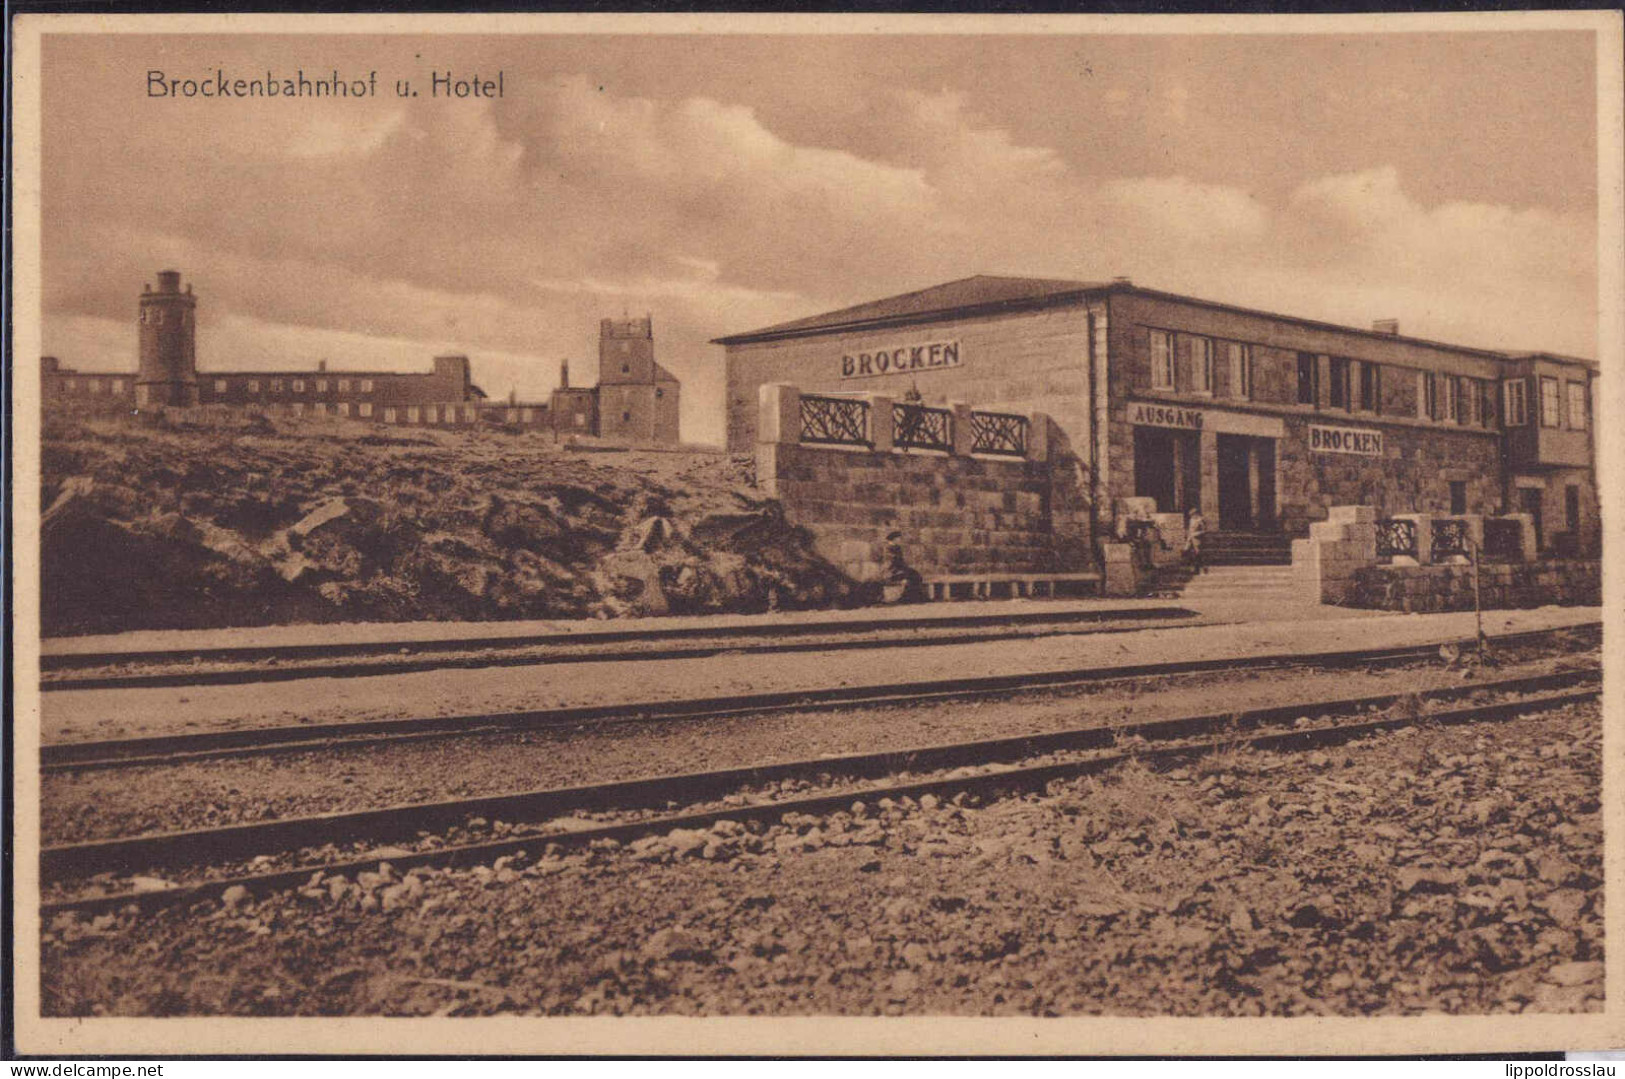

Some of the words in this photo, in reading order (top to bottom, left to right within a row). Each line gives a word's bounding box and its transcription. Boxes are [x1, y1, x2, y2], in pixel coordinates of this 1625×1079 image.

[842, 342, 959, 376] BROCKEN
[1135, 405, 1203, 428] AUSGANG
[1311, 428, 1381, 452] BROCKEN
